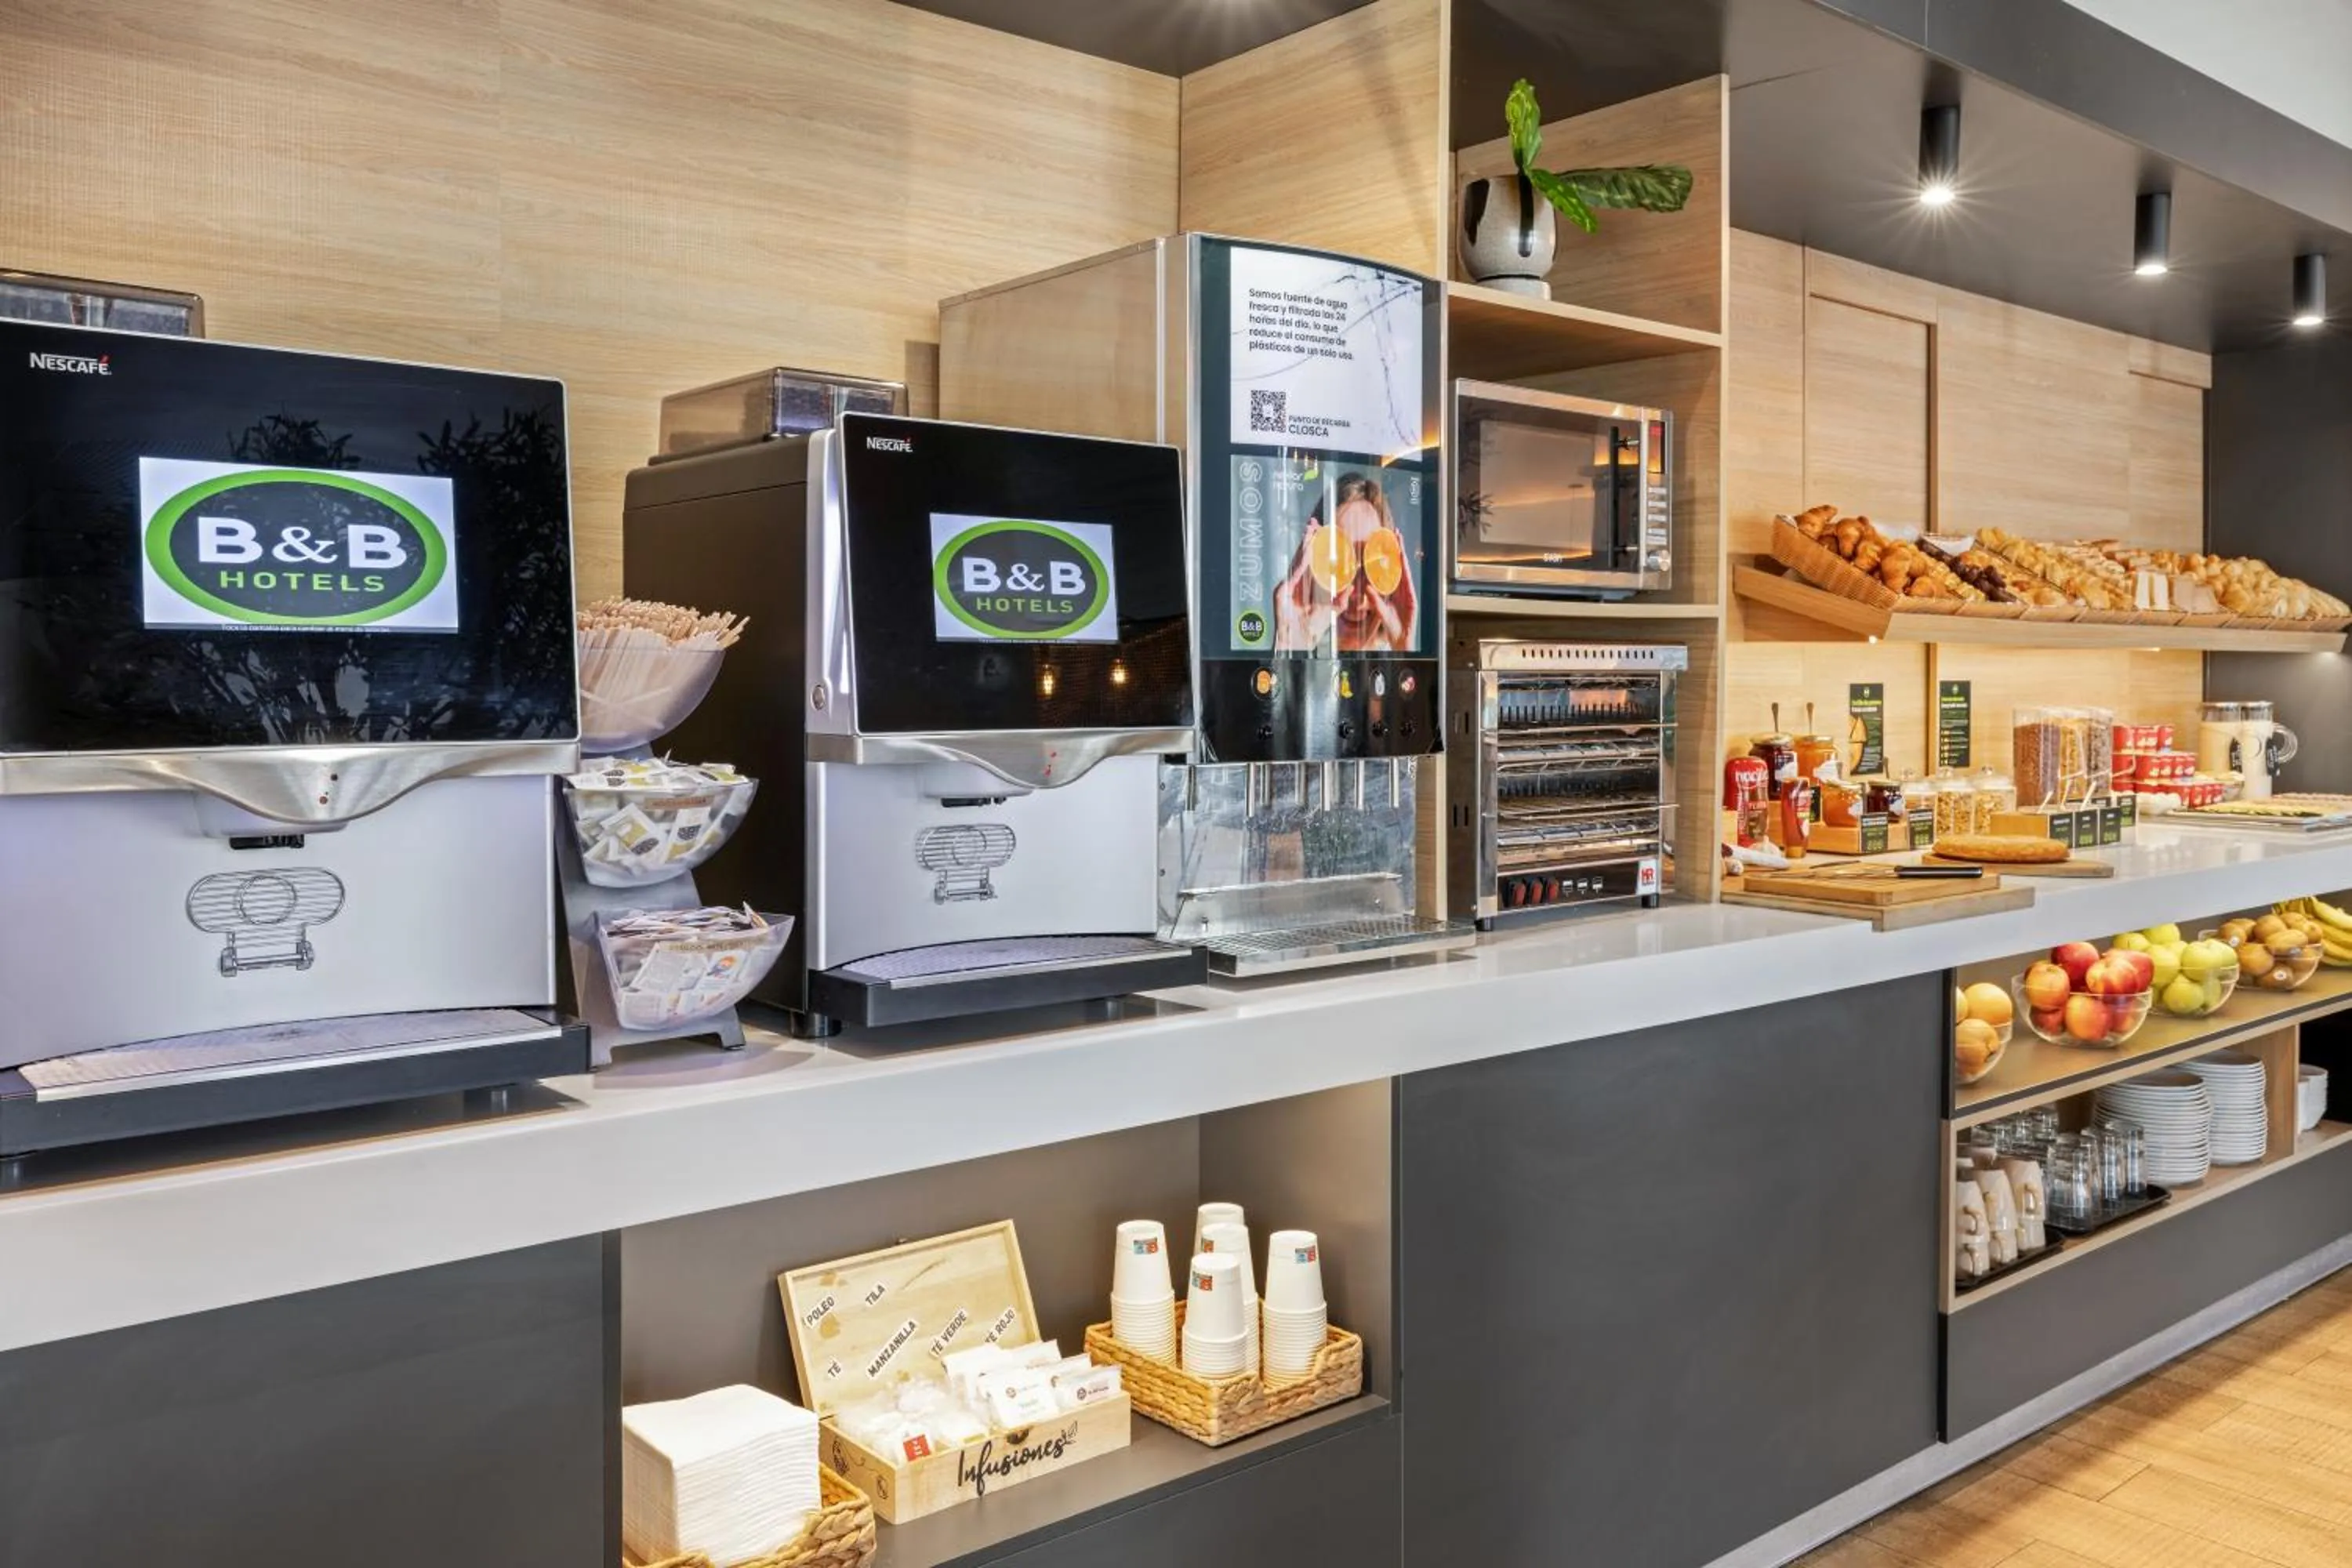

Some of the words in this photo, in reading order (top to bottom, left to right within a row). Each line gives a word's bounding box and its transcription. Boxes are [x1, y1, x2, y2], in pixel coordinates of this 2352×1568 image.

[1249, 288, 1282, 300] Somos
[1283, 291, 1313, 303] fuente
[1313, 296, 1325, 305] de
[1326, 299, 1348, 310] agua
[1249, 300, 1279, 312] fresca
[1280, 306, 1287, 315] y
[1288, 305, 1321, 318] filtrada
[1335, 311, 1346, 321] 24
[1249, 314, 1277, 325] horas
[1279, 318, 1293, 326] del
[1313, 321, 1321, 330] lo
[1323, 324, 1338, 334] que
[1249, 328, 1283, 339] reduce
[1284, 331, 1293, 339] el
[1294, 333, 1335, 345] consumo
[1335, 337, 1346, 346] de
[1293, 345, 1305, 354] de
[1319, 349, 1338, 358] solo
[1288, 424, 1329, 437] CLOSCA
[197, 515, 408, 570] B&B
[1240, 463, 1263, 601] ZUMOS
[219, 570, 385, 593] HOTELS
[962, 557, 1086, 596] B&B
[975, 597, 1074, 614] HOTELS
[865, 1284, 885, 1305] TILA
[806, 1295, 836, 1326] POLEO
[995, 1308, 1016, 1334] ROJO
[940, 1309, 967, 1343] VERDE
[867, 1319, 917, 1378] MANZANILLA
[956, 1433, 1065, 1497] Infusiones
